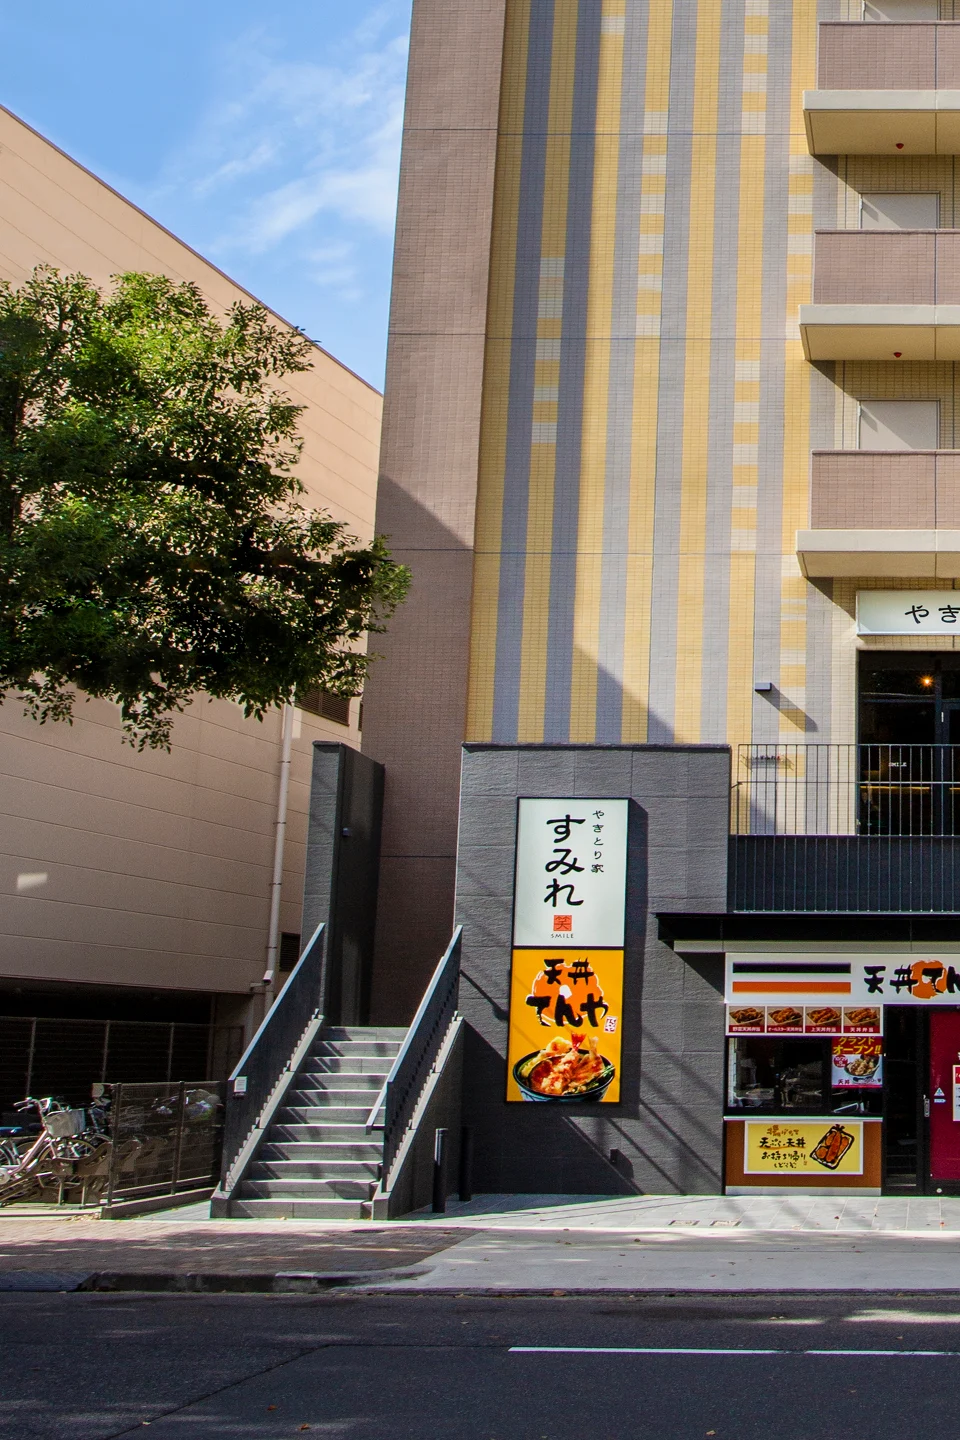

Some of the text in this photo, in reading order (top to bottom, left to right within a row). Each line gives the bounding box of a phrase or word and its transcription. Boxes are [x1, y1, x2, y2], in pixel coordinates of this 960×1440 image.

[543, 813, 587, 908] すみれ
[590, 809, 605, 874] やきとり家
[543, 956, 595, 986] 天丼
[525, 993, 609, 1028] てんや
